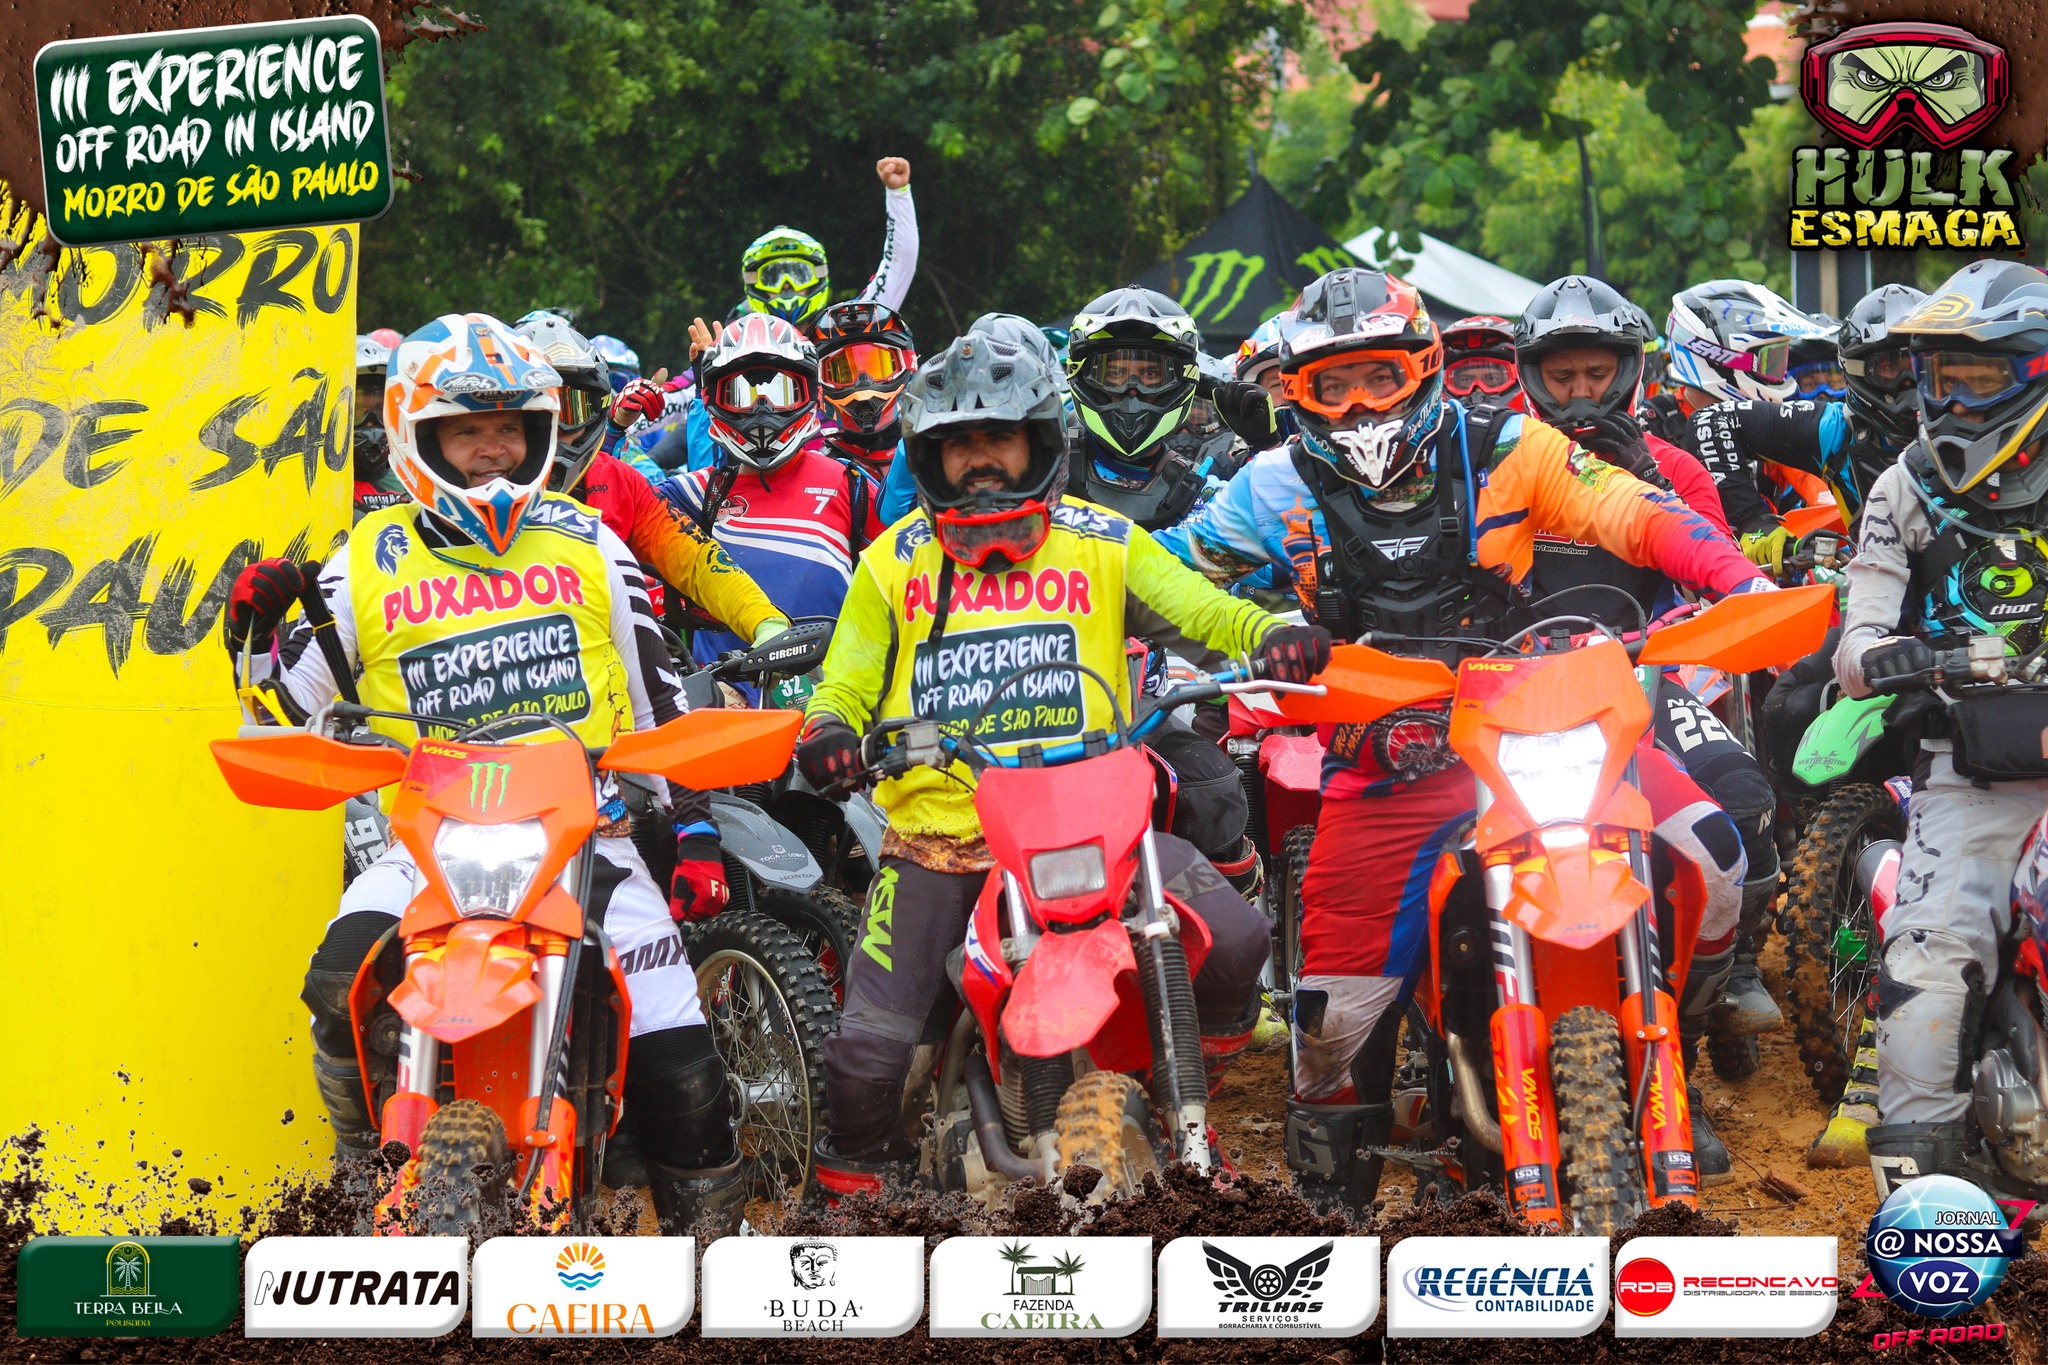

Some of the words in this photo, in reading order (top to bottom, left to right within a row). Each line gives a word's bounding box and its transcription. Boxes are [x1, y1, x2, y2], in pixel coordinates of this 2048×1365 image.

[0, 227, 353, 332] ORRO
[189, 366, 353, 497] SÃO
[813, 495, 831, 515] 7
[383, 565, 584, 633] PUXADOR
[904, 567, 1092, 622] PUXADOR
[1989, 602, 2039, 616] thor
[407, 661, 428, 692] III
[432, 623, 572, 684] EXPERIENCE
[768, 643, 808, 662] CIRCUIT
[915, 655, 934, 687] III
[937, 633, 1071, 680] EXPERIENCE
[1467, 662, 1516, 672] VAMOS
[416, 689, 444, 716] OFF
[449, 676, 496, 711] ROAD
[502, 671, 521, 694] IN
[526, 656, 577, 689] ISLAND
[543, 690, 586, 716] PAULO
[780, 674, 804, 699] 32
[917, 685, 944, 716] OFF
[948, 678, 994, 709] ROAD
[1022, 669, 1076, 699] ISLAND
[1000, 708, 1030, 733] SÃO
[1034, 705, 1079, 729] PAULO
[421, 744, 469, 760] VAMOS
[759, 852, 781, 863] TOCA
[778, 872, 816, 882] HONDA
[1521, 1067, 1543, 1142] VAMOS
[1651, 1057, 1667, 1131] VAMO
